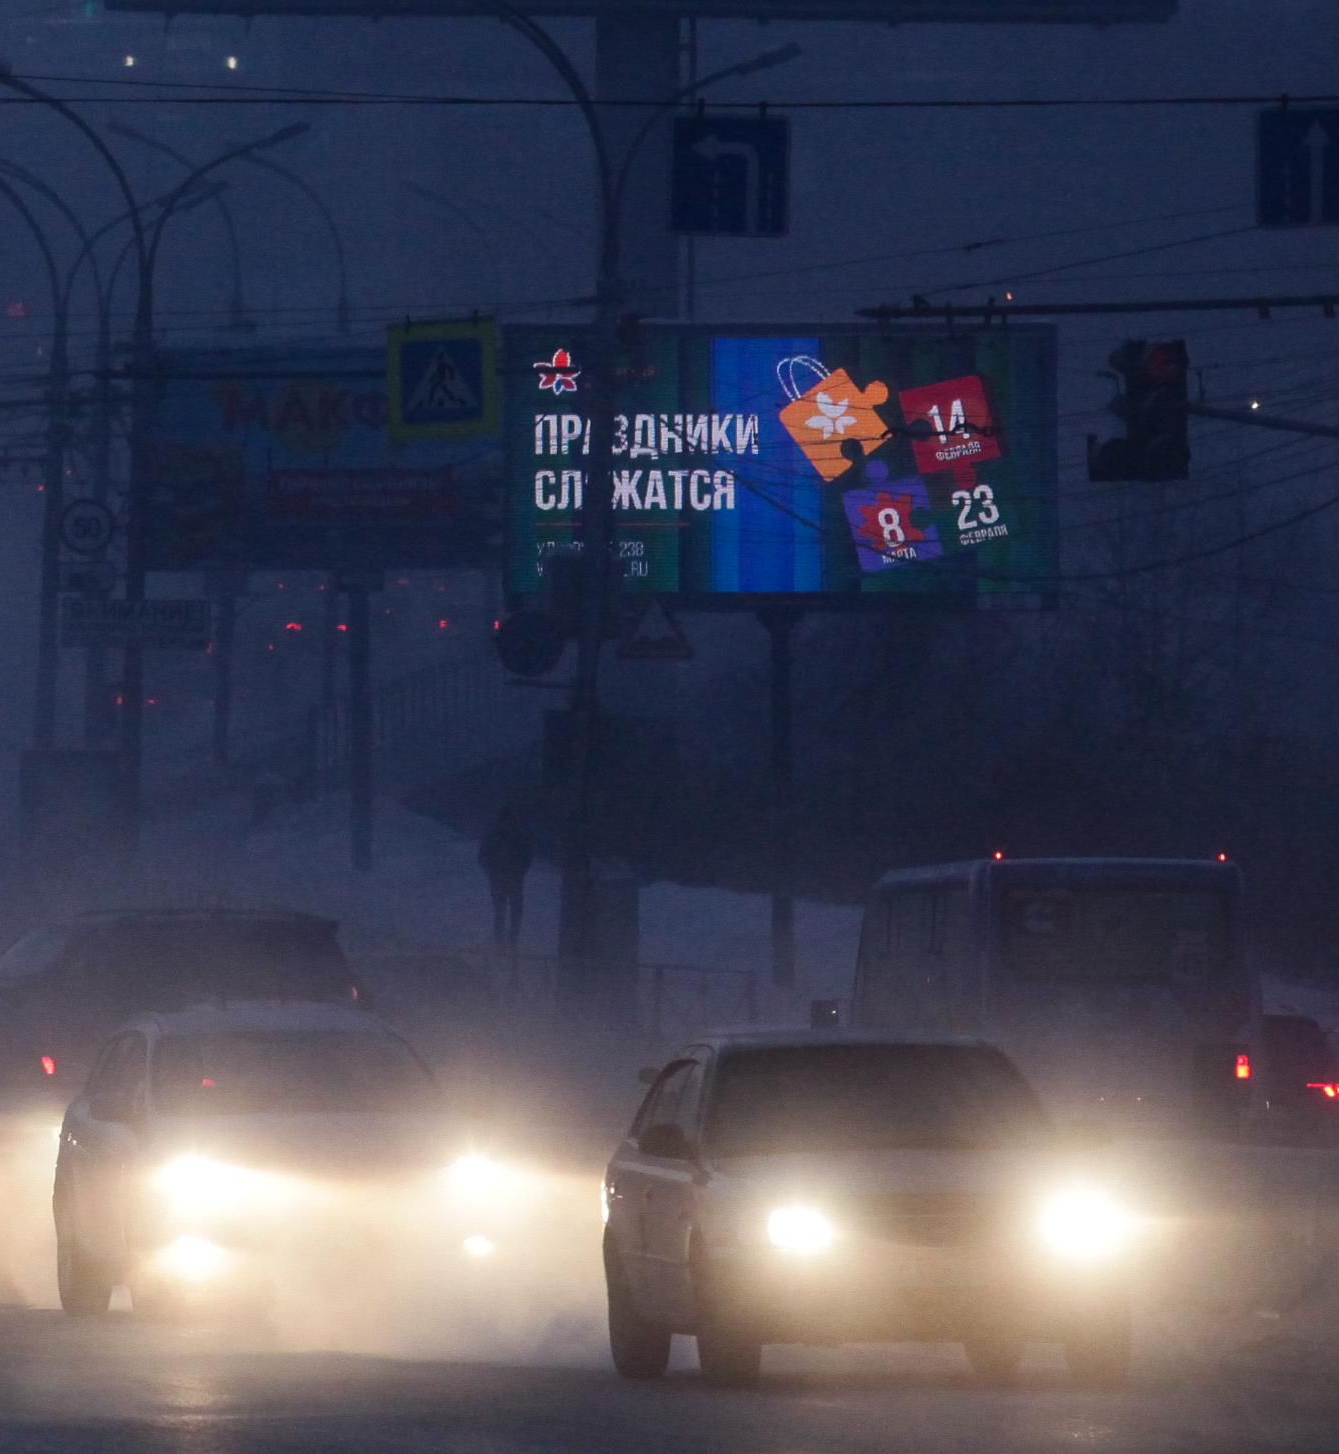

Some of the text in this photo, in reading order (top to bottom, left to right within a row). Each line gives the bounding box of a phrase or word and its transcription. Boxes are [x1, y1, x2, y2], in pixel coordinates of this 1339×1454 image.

[927, 398, 971, 444] 14
[534, 470, 736, 511] СЛЖАТСЯ
[951, 484, 1000, 531] 23
[877, 507, 906, 548] 8
